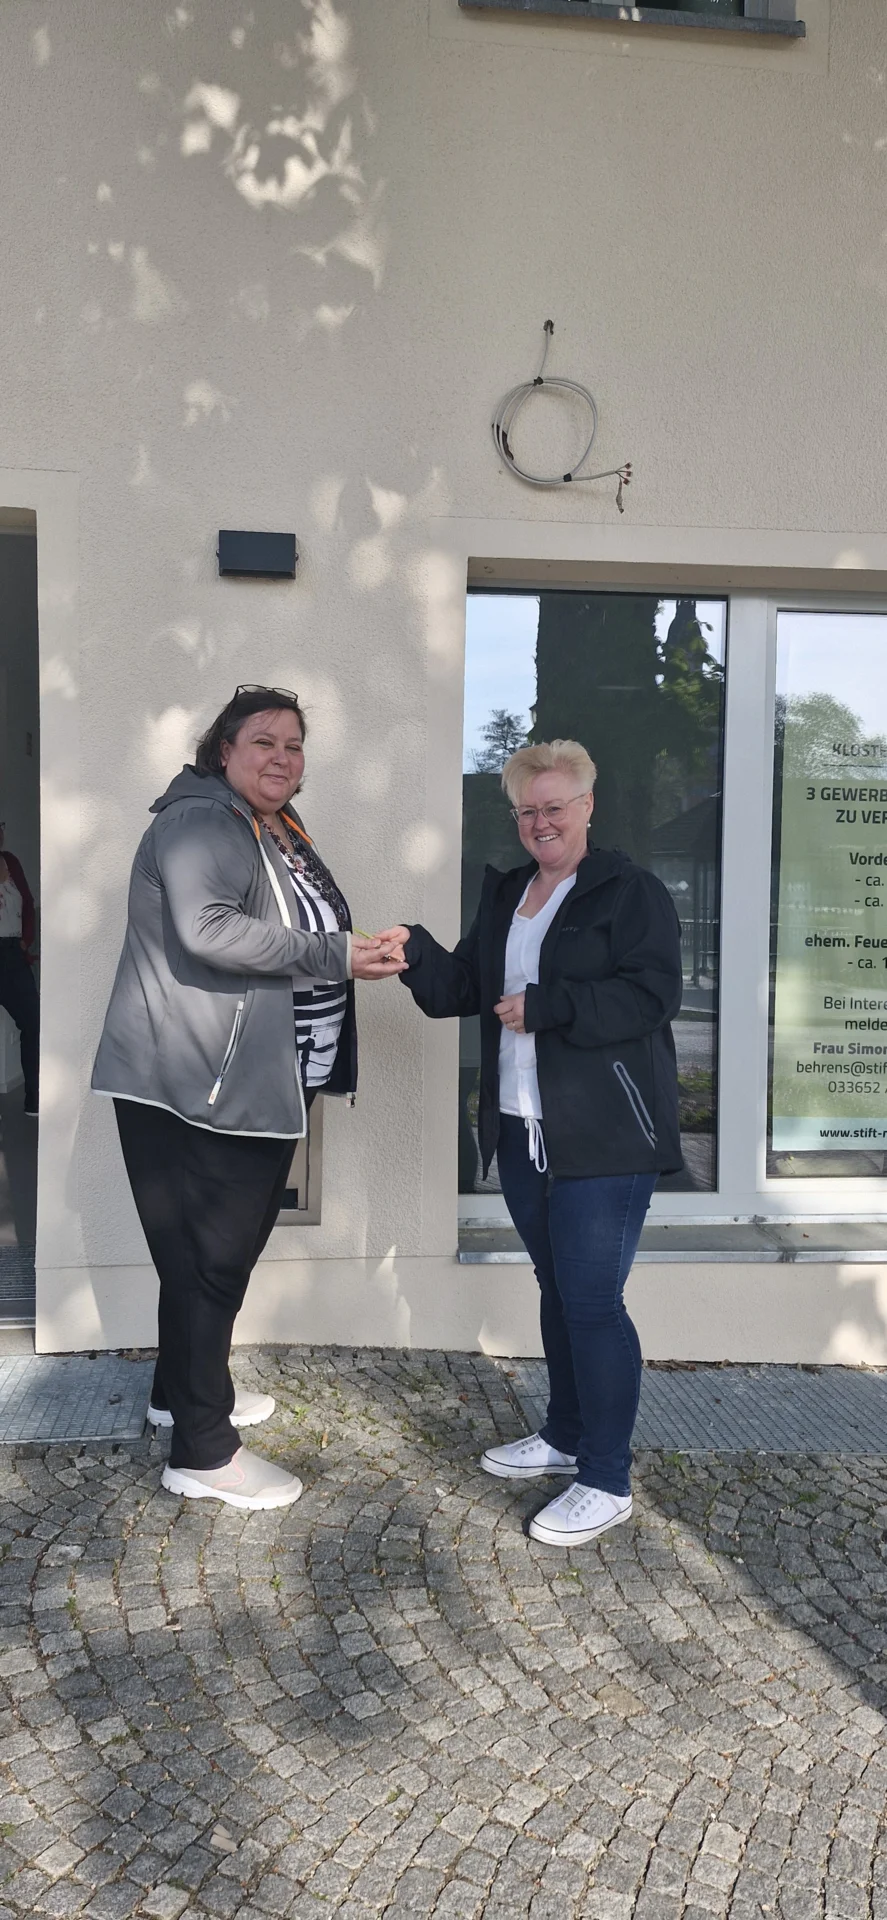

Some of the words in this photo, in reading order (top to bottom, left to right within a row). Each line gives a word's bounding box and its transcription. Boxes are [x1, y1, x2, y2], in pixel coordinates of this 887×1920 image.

[806, 787, 816, 801] 3
[820, 787, 887, 802] GEWERB
[836, 809, 857, 824] ZU
[865, 876, 885, 887] ca.
[864, 896, 884, 907] ca.
[805, 934, 850, 948] ehem.
[854, 935, 887, 948] Feue
[857, 958, 877, 969] ca.
[824, 996, 846, 1009] Bei
[845, 1017, 887, 1031] melde
[813, 1042, 844, 1055] Frau
[828, 1081, 880, 1094] 033652
